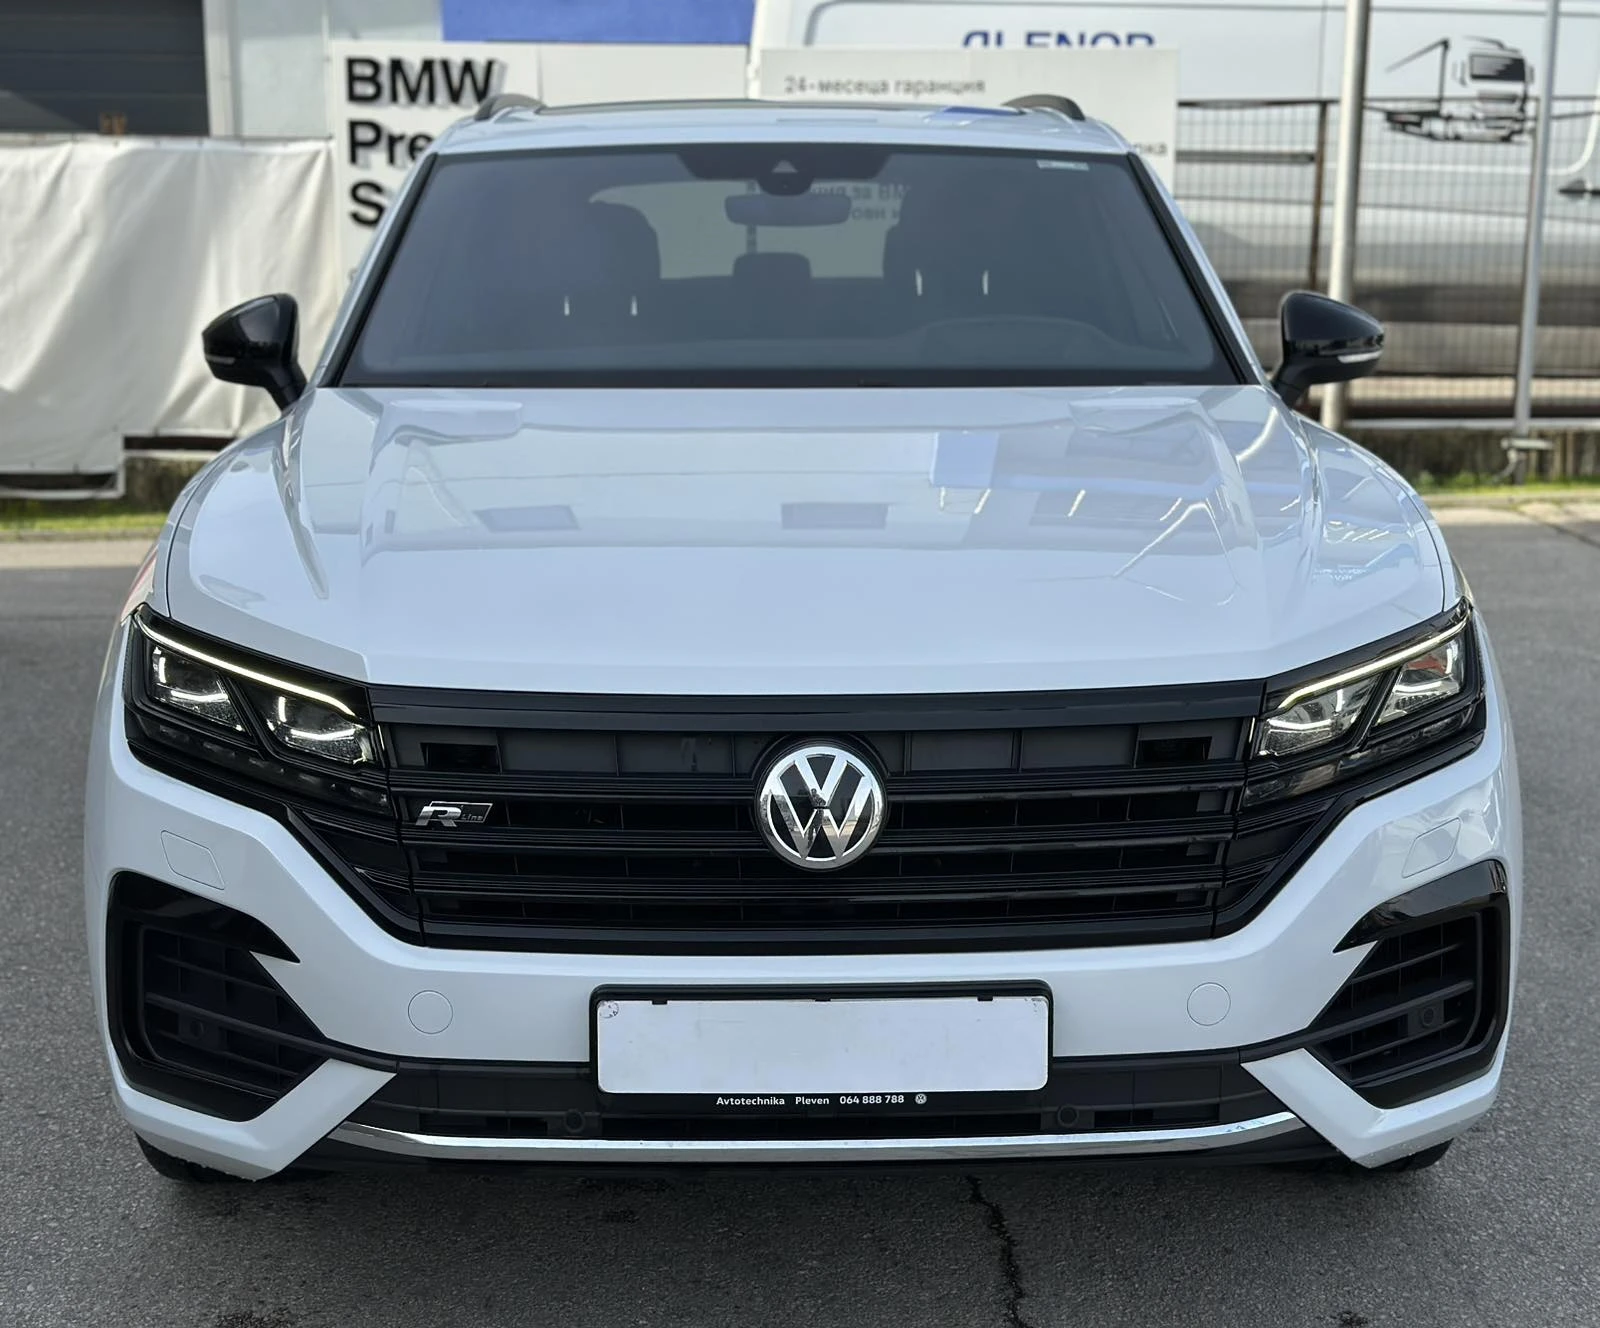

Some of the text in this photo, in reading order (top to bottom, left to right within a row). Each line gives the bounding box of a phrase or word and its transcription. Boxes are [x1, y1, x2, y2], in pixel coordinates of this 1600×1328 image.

[346, 57, 497, 105] BMW
[895, 80, 986, 98] гаранция
[347, 119, 434, 165] Pre
[716, 1096, 786, 1106] Avtotechnika
[795, 1096, 830, 1105] Pleven
[839, 1095, 860, 1105] 064
[862, 1095, 882, 1104] 888
[885, 1094, 905, 1104] 788
